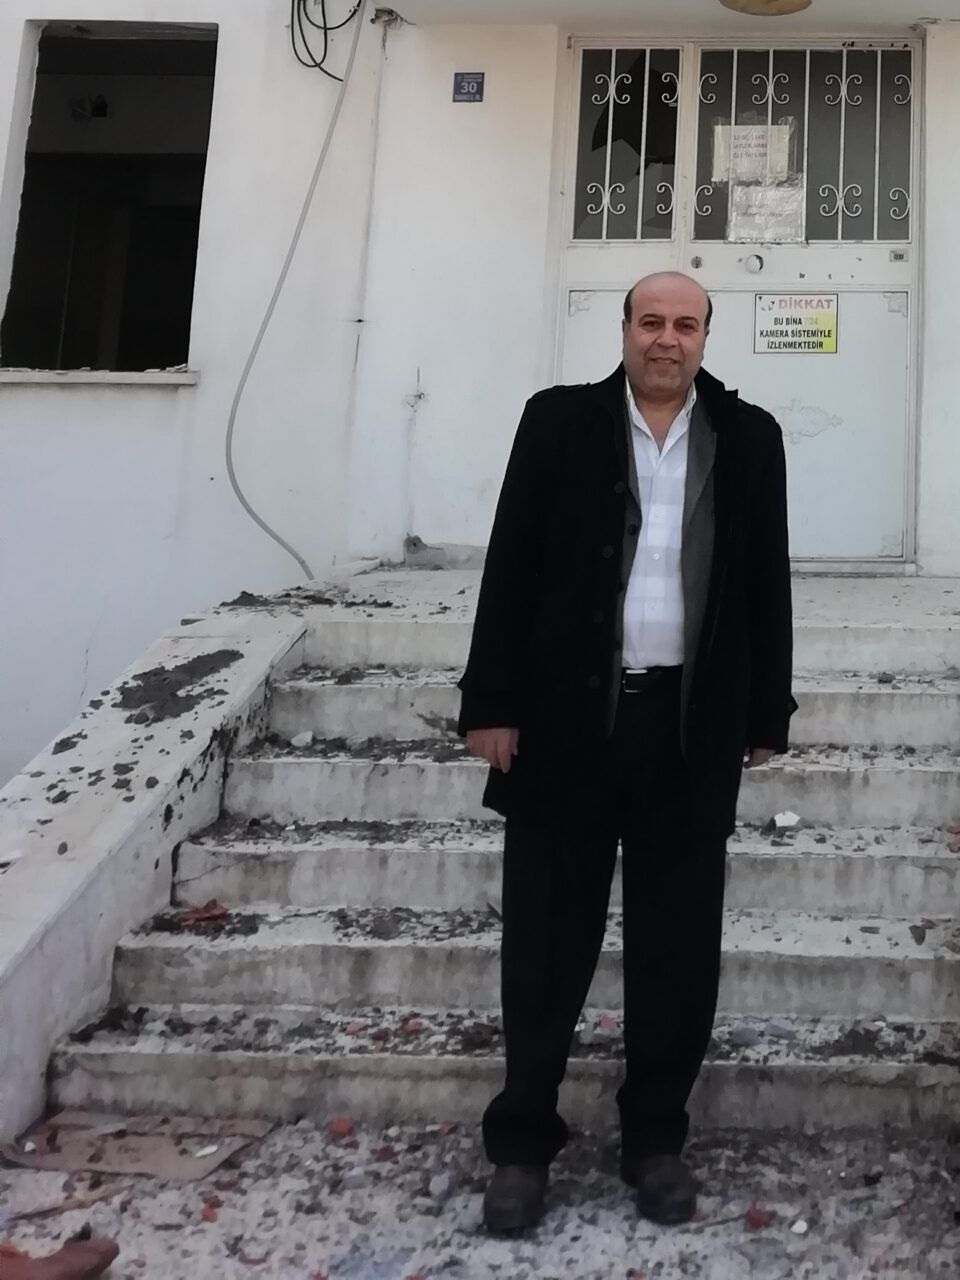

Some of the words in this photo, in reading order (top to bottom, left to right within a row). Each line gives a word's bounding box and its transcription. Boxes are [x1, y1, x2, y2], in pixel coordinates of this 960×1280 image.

[460, 82, 477, 93] 30
[778, 297, 833, 310] DİKKAT
[774, 317, 784, 326] BU
[785, 316, 803, 326] BİNA
[760, 329, 789, 338] KAMERA
[790, 328, 832, 338] SİSTEMİYLE
[767, 340, 824, 350] İZLENMEKTEDİR
